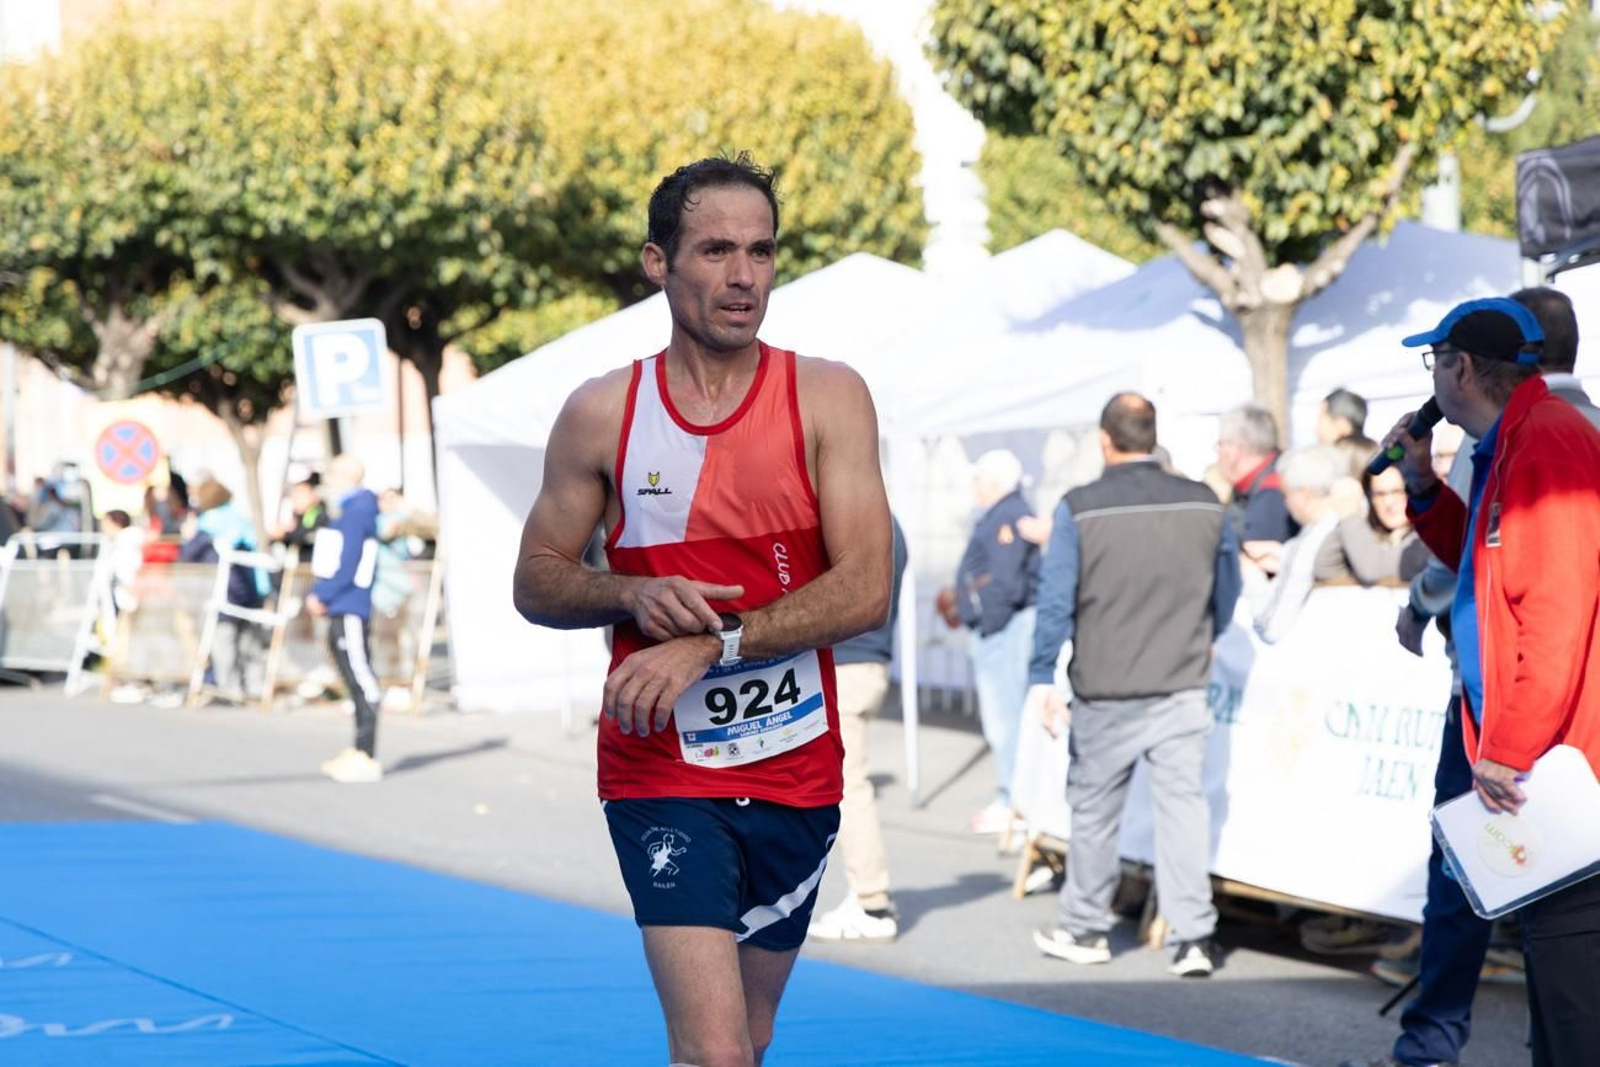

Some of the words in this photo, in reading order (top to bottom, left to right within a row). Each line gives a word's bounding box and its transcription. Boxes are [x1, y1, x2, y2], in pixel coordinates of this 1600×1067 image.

[312, 333, 370, 407] P
[636, 487, 673, 496] SPALL
[772, 542, 791, 586] CLUB
[704, 667, 801, 726] 924
[727, 721, 763, 736] MIGUEL
